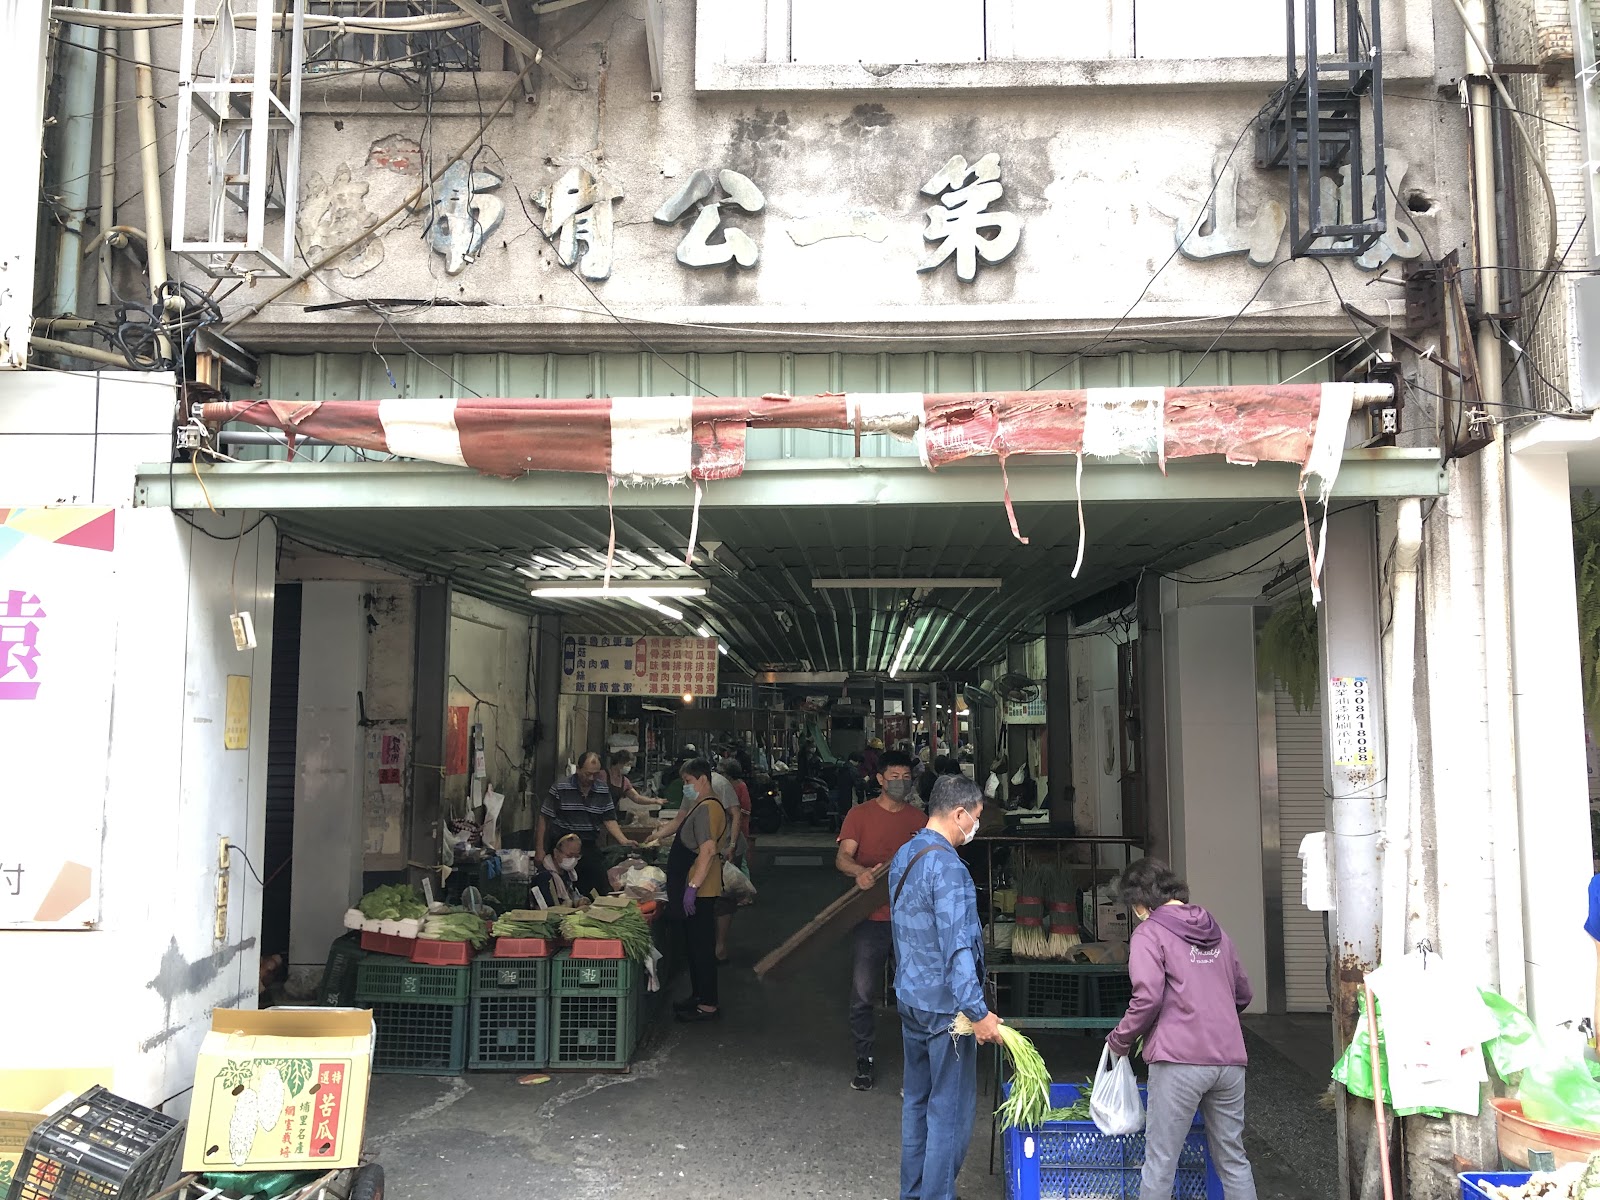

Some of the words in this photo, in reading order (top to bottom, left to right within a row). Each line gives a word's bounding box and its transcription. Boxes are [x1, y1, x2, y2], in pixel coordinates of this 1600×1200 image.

[1353, 680, 1368, 762] 0908418088
[279, 1105, 296, 1159] 網室栽培
[294, 1101, 311, 1155] 埔里名產
[314, 1092, 336, 1141] 苦瓜
